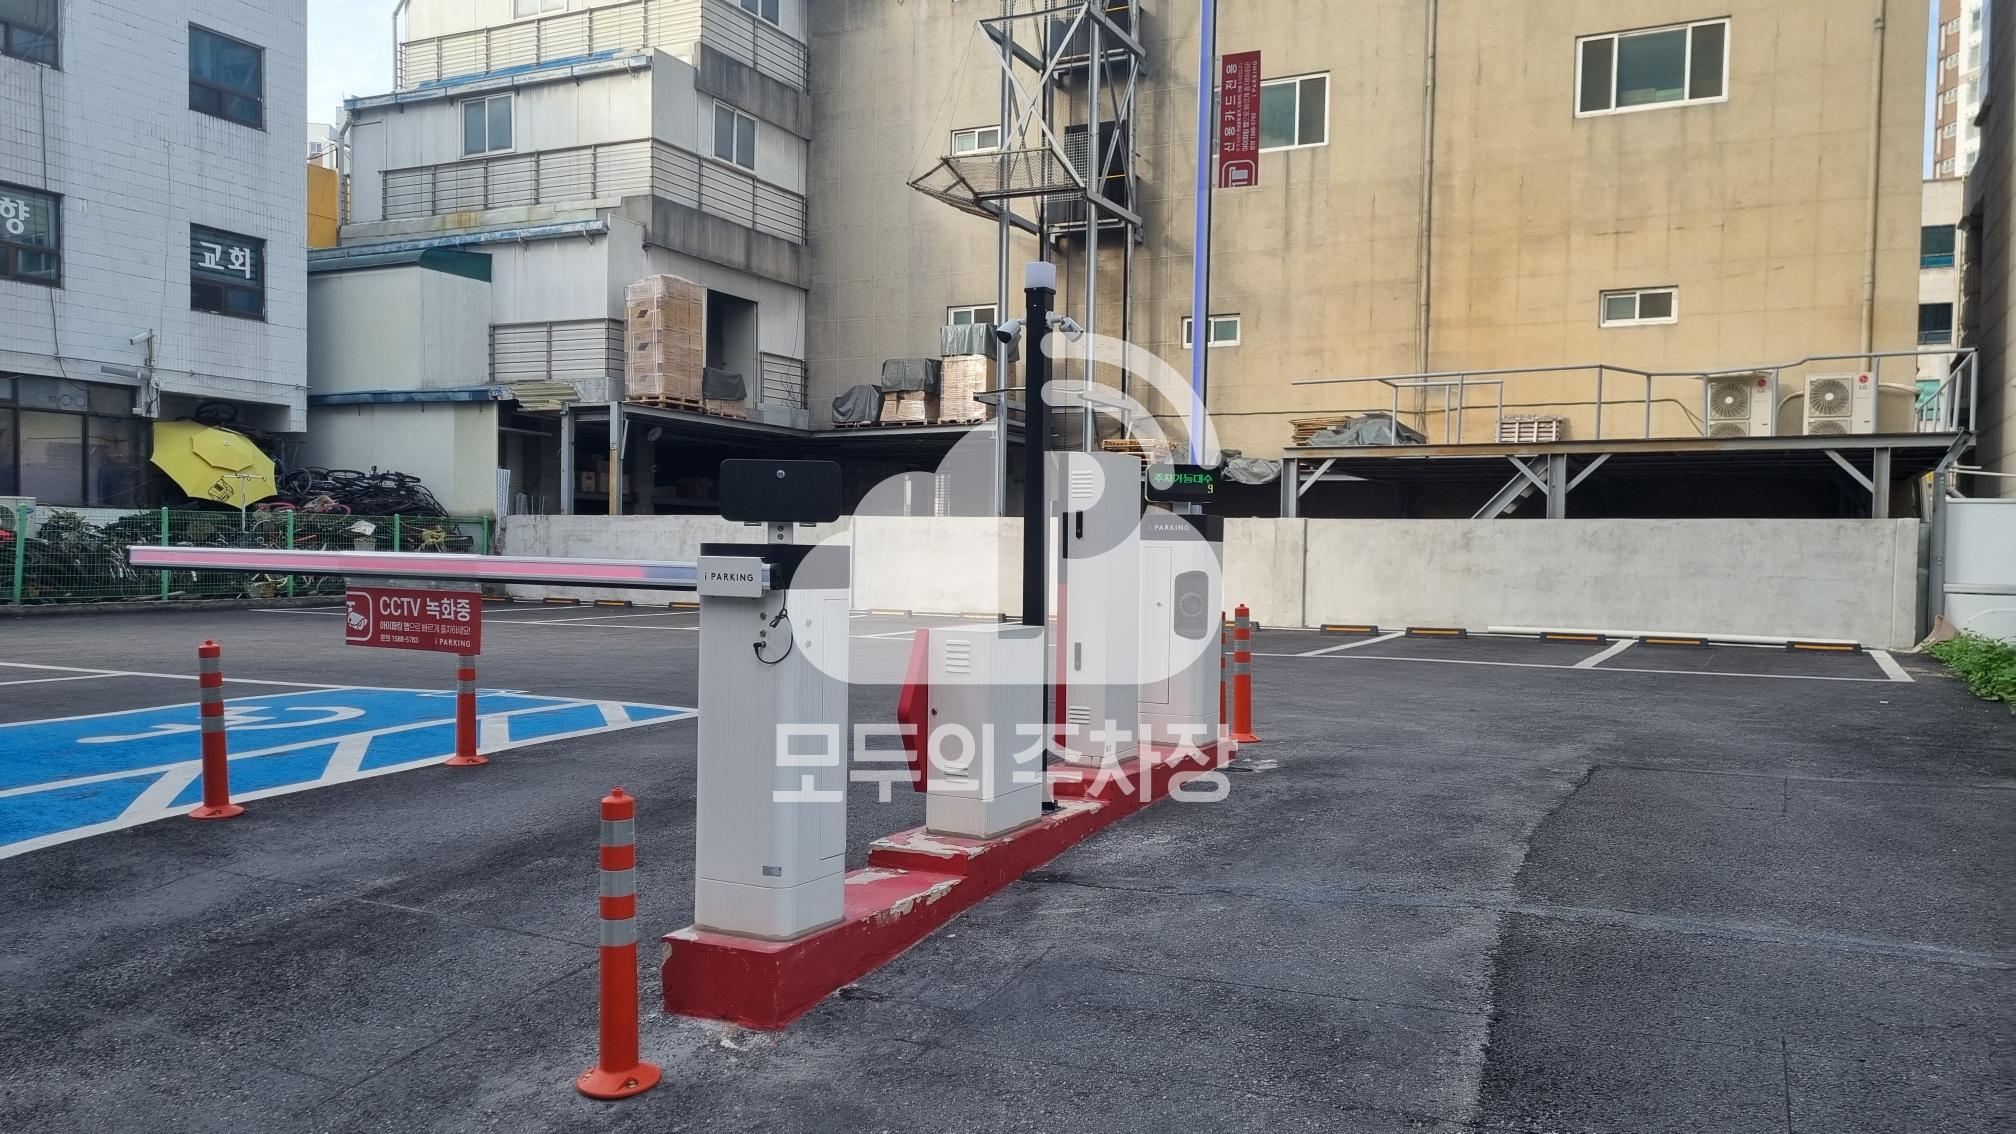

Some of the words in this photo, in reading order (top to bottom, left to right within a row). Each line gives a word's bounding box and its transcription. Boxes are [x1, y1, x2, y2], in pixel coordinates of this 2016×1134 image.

[0, 197, 30, 235] 향
[198, 241, 250, 279] 교회
[1154, 473, 1213, 484] 주차가능대수
[1207, 484, 1214, 494] 9
[711, 572, 754, 582] PARKING
[379, 596, 421, 616] CCTV
[426, 598, 470, 621] 녹화중
[439, 639, 471, 648] PARKING
